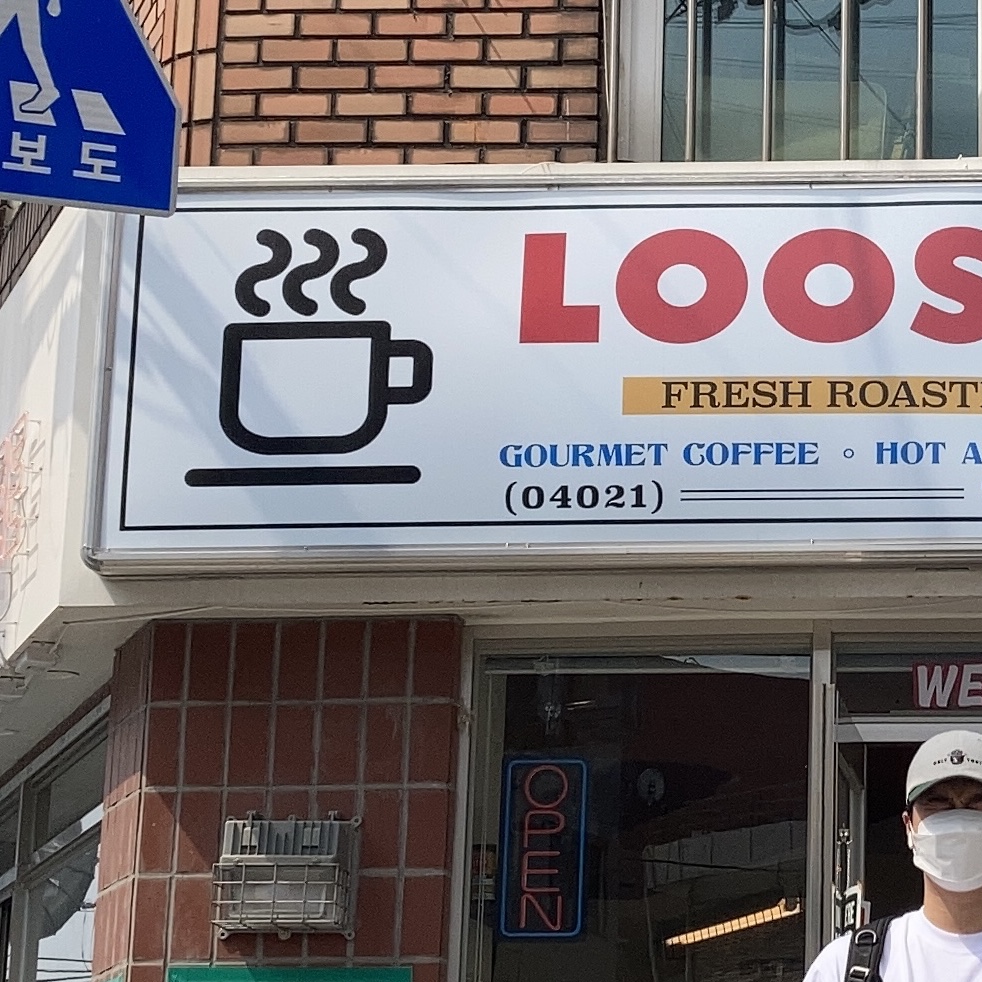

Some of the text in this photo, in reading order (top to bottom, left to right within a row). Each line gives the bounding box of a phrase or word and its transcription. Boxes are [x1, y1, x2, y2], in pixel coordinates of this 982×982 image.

[661, 379, 812, 409] FRESH
[499, 443, 668, 468] GOURMET
[683, 442, 819, 467] COFFEE
[875, 441, 946, 466] HOT
[504, 480, 664, 516] (04021)
[519, 764, 569, 932] OPEN
